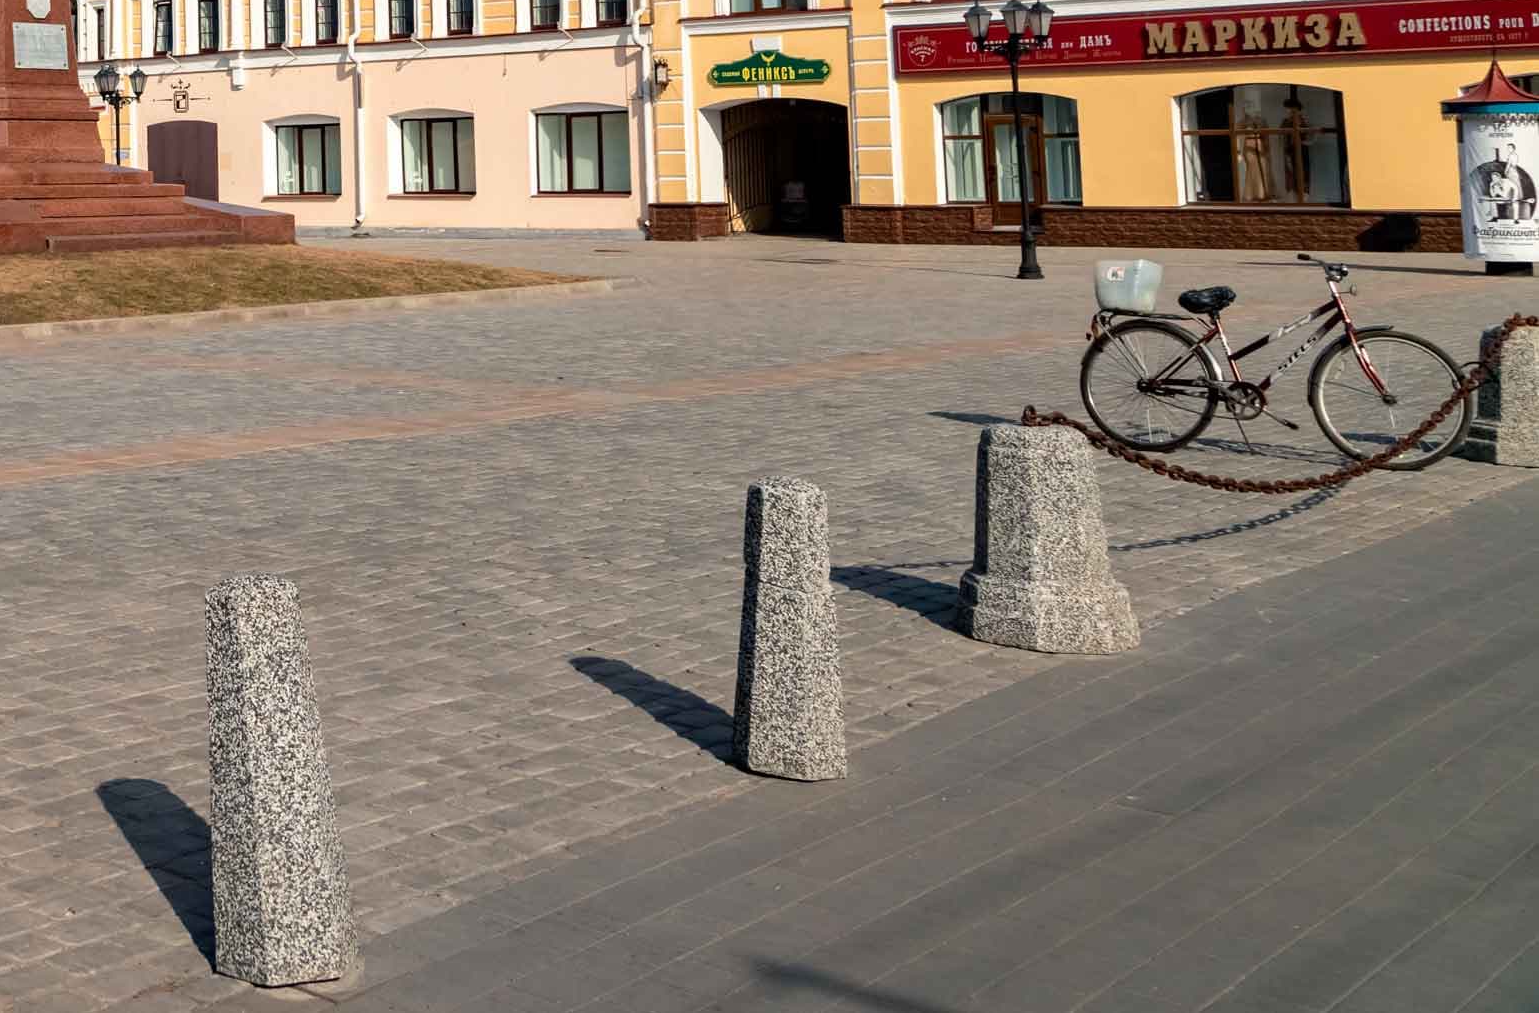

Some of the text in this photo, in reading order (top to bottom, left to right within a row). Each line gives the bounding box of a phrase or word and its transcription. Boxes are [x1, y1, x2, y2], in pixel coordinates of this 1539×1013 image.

[1399, 15, 1491, 33] CONFECTIONS
[1498, 17, 1525, 29] POUR
[1079, 34, 1112, 50] ДАМЪ
[1146, 12, 1367, 55] МАРКИЗА
[742, 67, 796, 82] ФЕНИКСЪ
